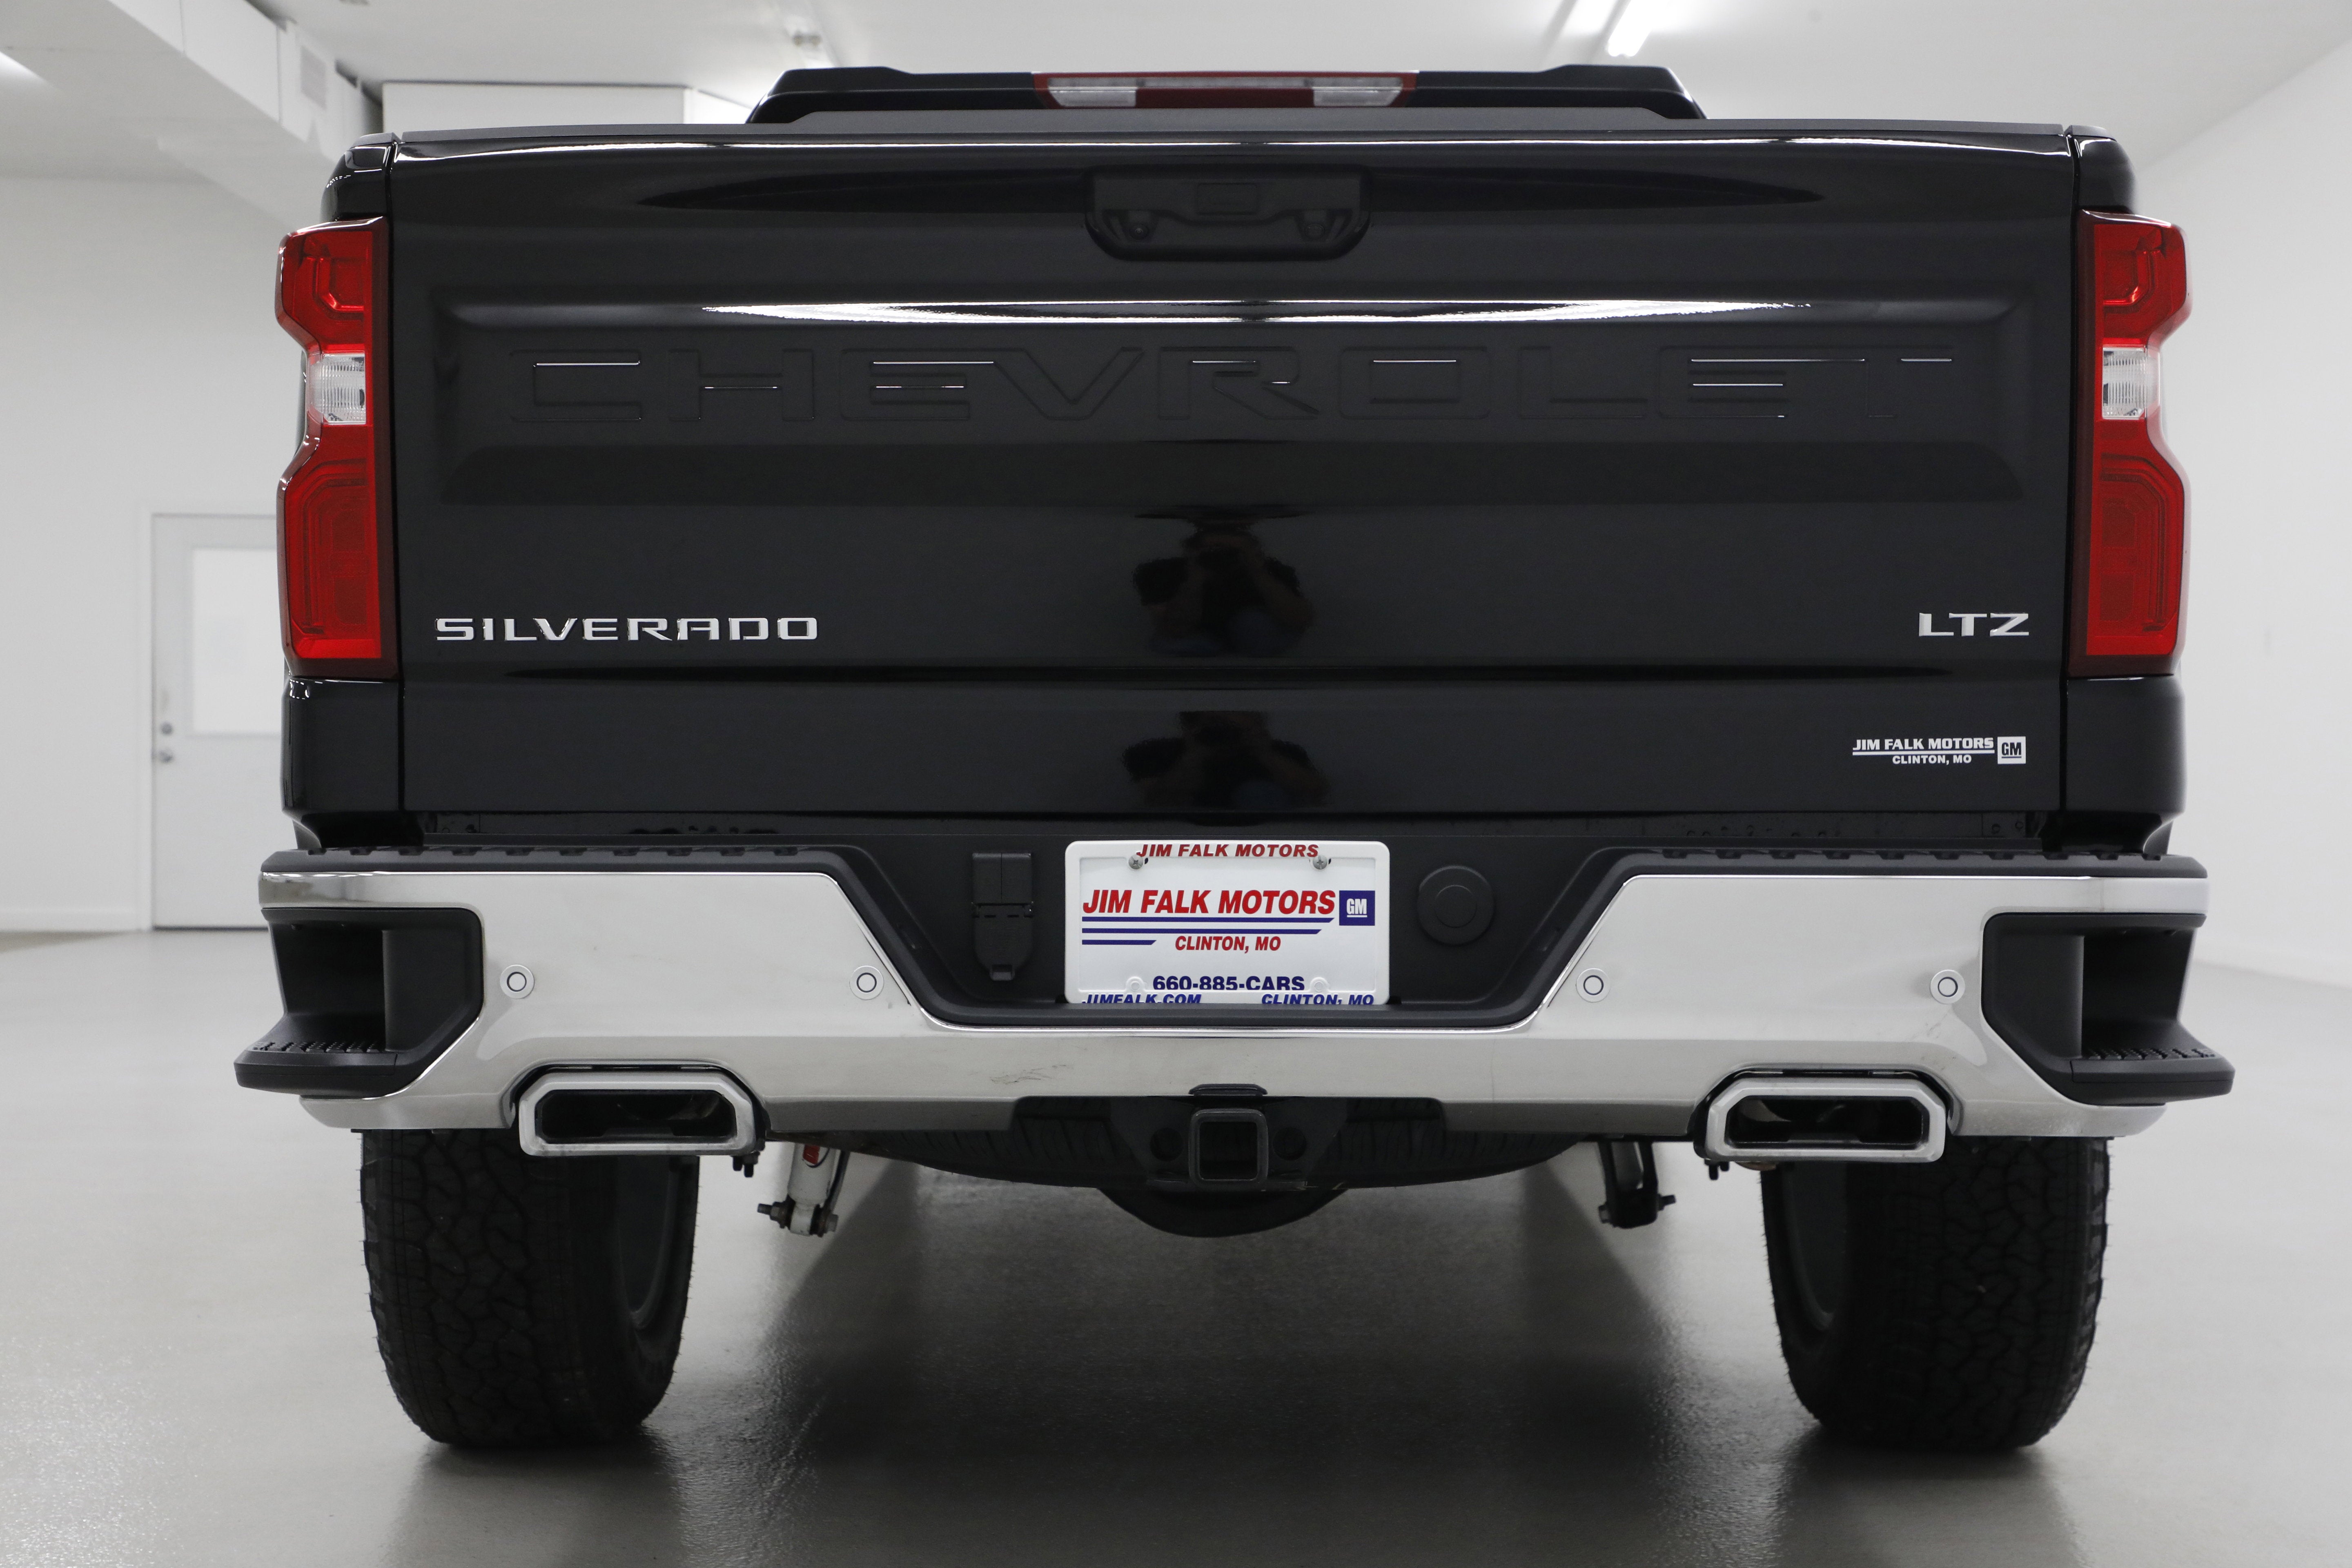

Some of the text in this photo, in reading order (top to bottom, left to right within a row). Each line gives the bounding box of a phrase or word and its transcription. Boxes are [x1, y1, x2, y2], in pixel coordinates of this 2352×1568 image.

[509, 345, 1954, 421] CHEVROLET
[435, 617, 817, 641] SILVERADO
[1919, 612, 2029, 637] LTZ
[1853, 737, 1994, 751] JIM FALK MOTORS
[2001, 742, 2022, 756] GM
[1892, 755, 1972, 765] CLINTON, MO
[1136, 844, 1319, 858] JIM FALK MOTORS
[1083, 890, 1336, 914] JIM FALK MOTORS
[1346, 898, 1367, 915] GM
[1175, 935, 1281, 954] CLINTON, MO
[1153, 976, 1305, 991] 660-885-CARS
[1262, 993, 1374, 1005] CLINTON, MO
